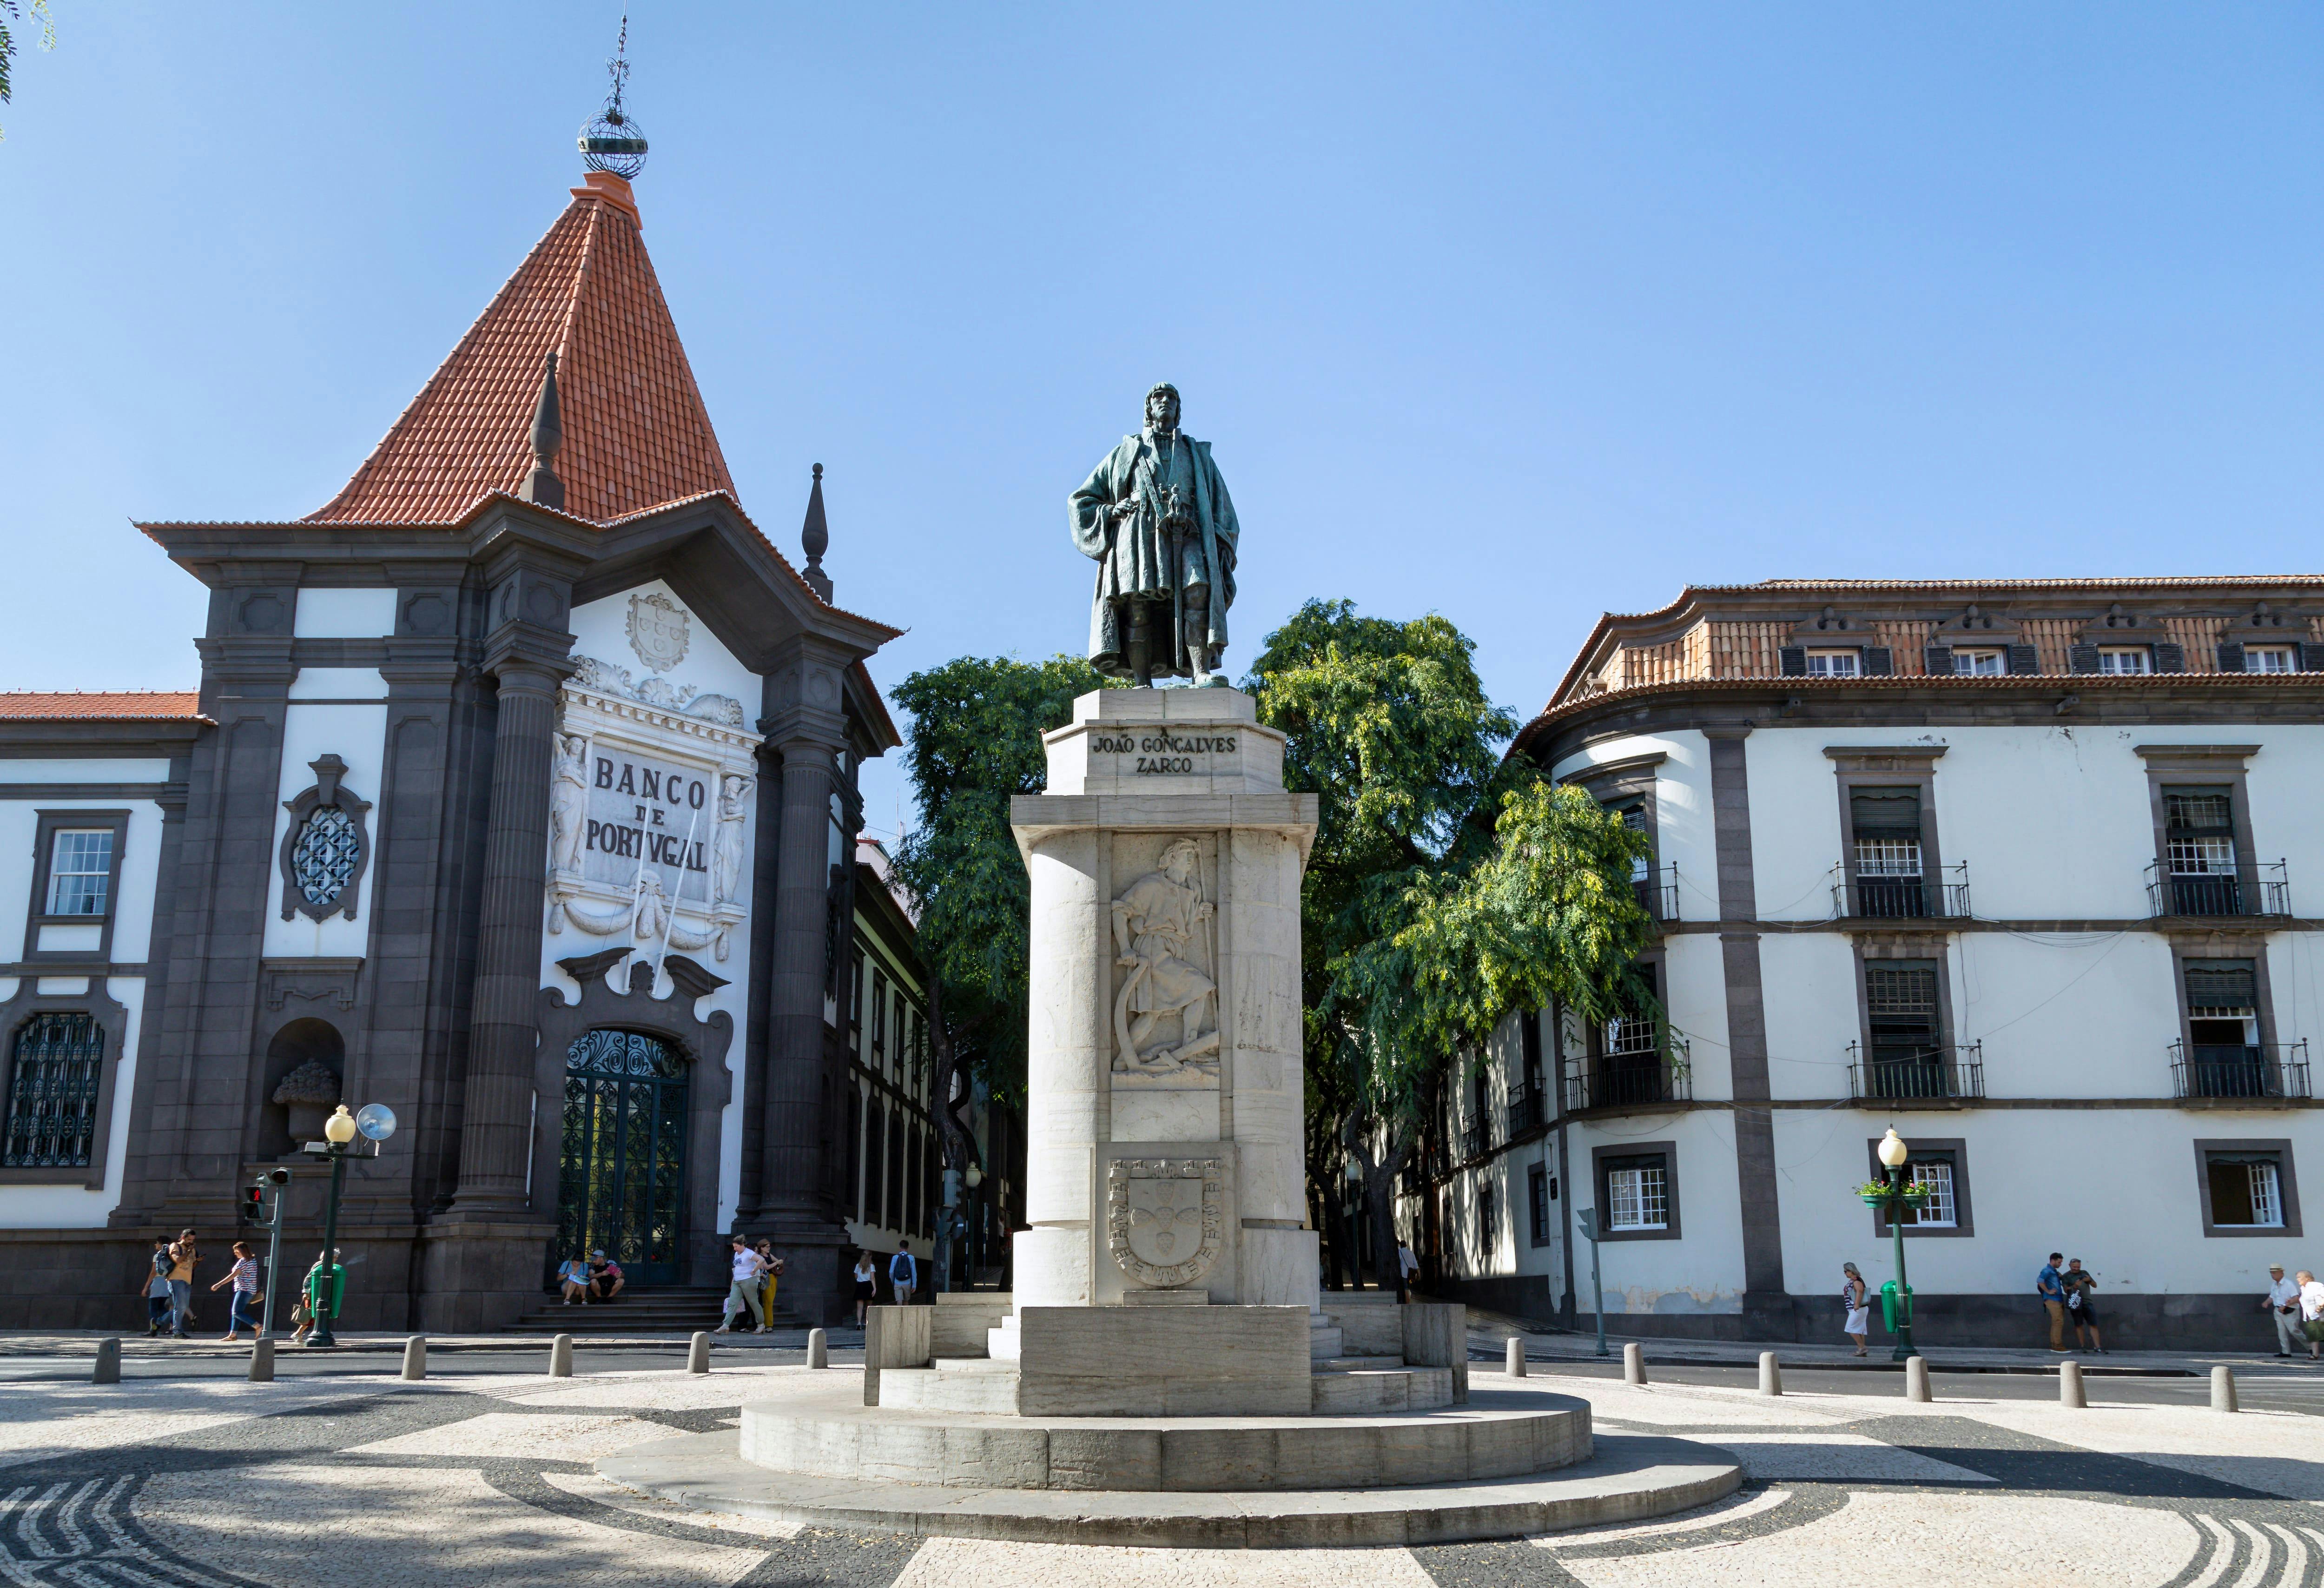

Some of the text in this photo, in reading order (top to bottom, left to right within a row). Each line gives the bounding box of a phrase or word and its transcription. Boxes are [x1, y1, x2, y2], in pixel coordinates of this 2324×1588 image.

[1093, 734, 1235, 754] JOÃO GONÇALVES
[1137, 758, 1192, 774] ZARCO
[595, 757, 705, 810] BANCO
[635, 805, 665, 826] DE
[586, 819, 707, 873] PORTVGAL
